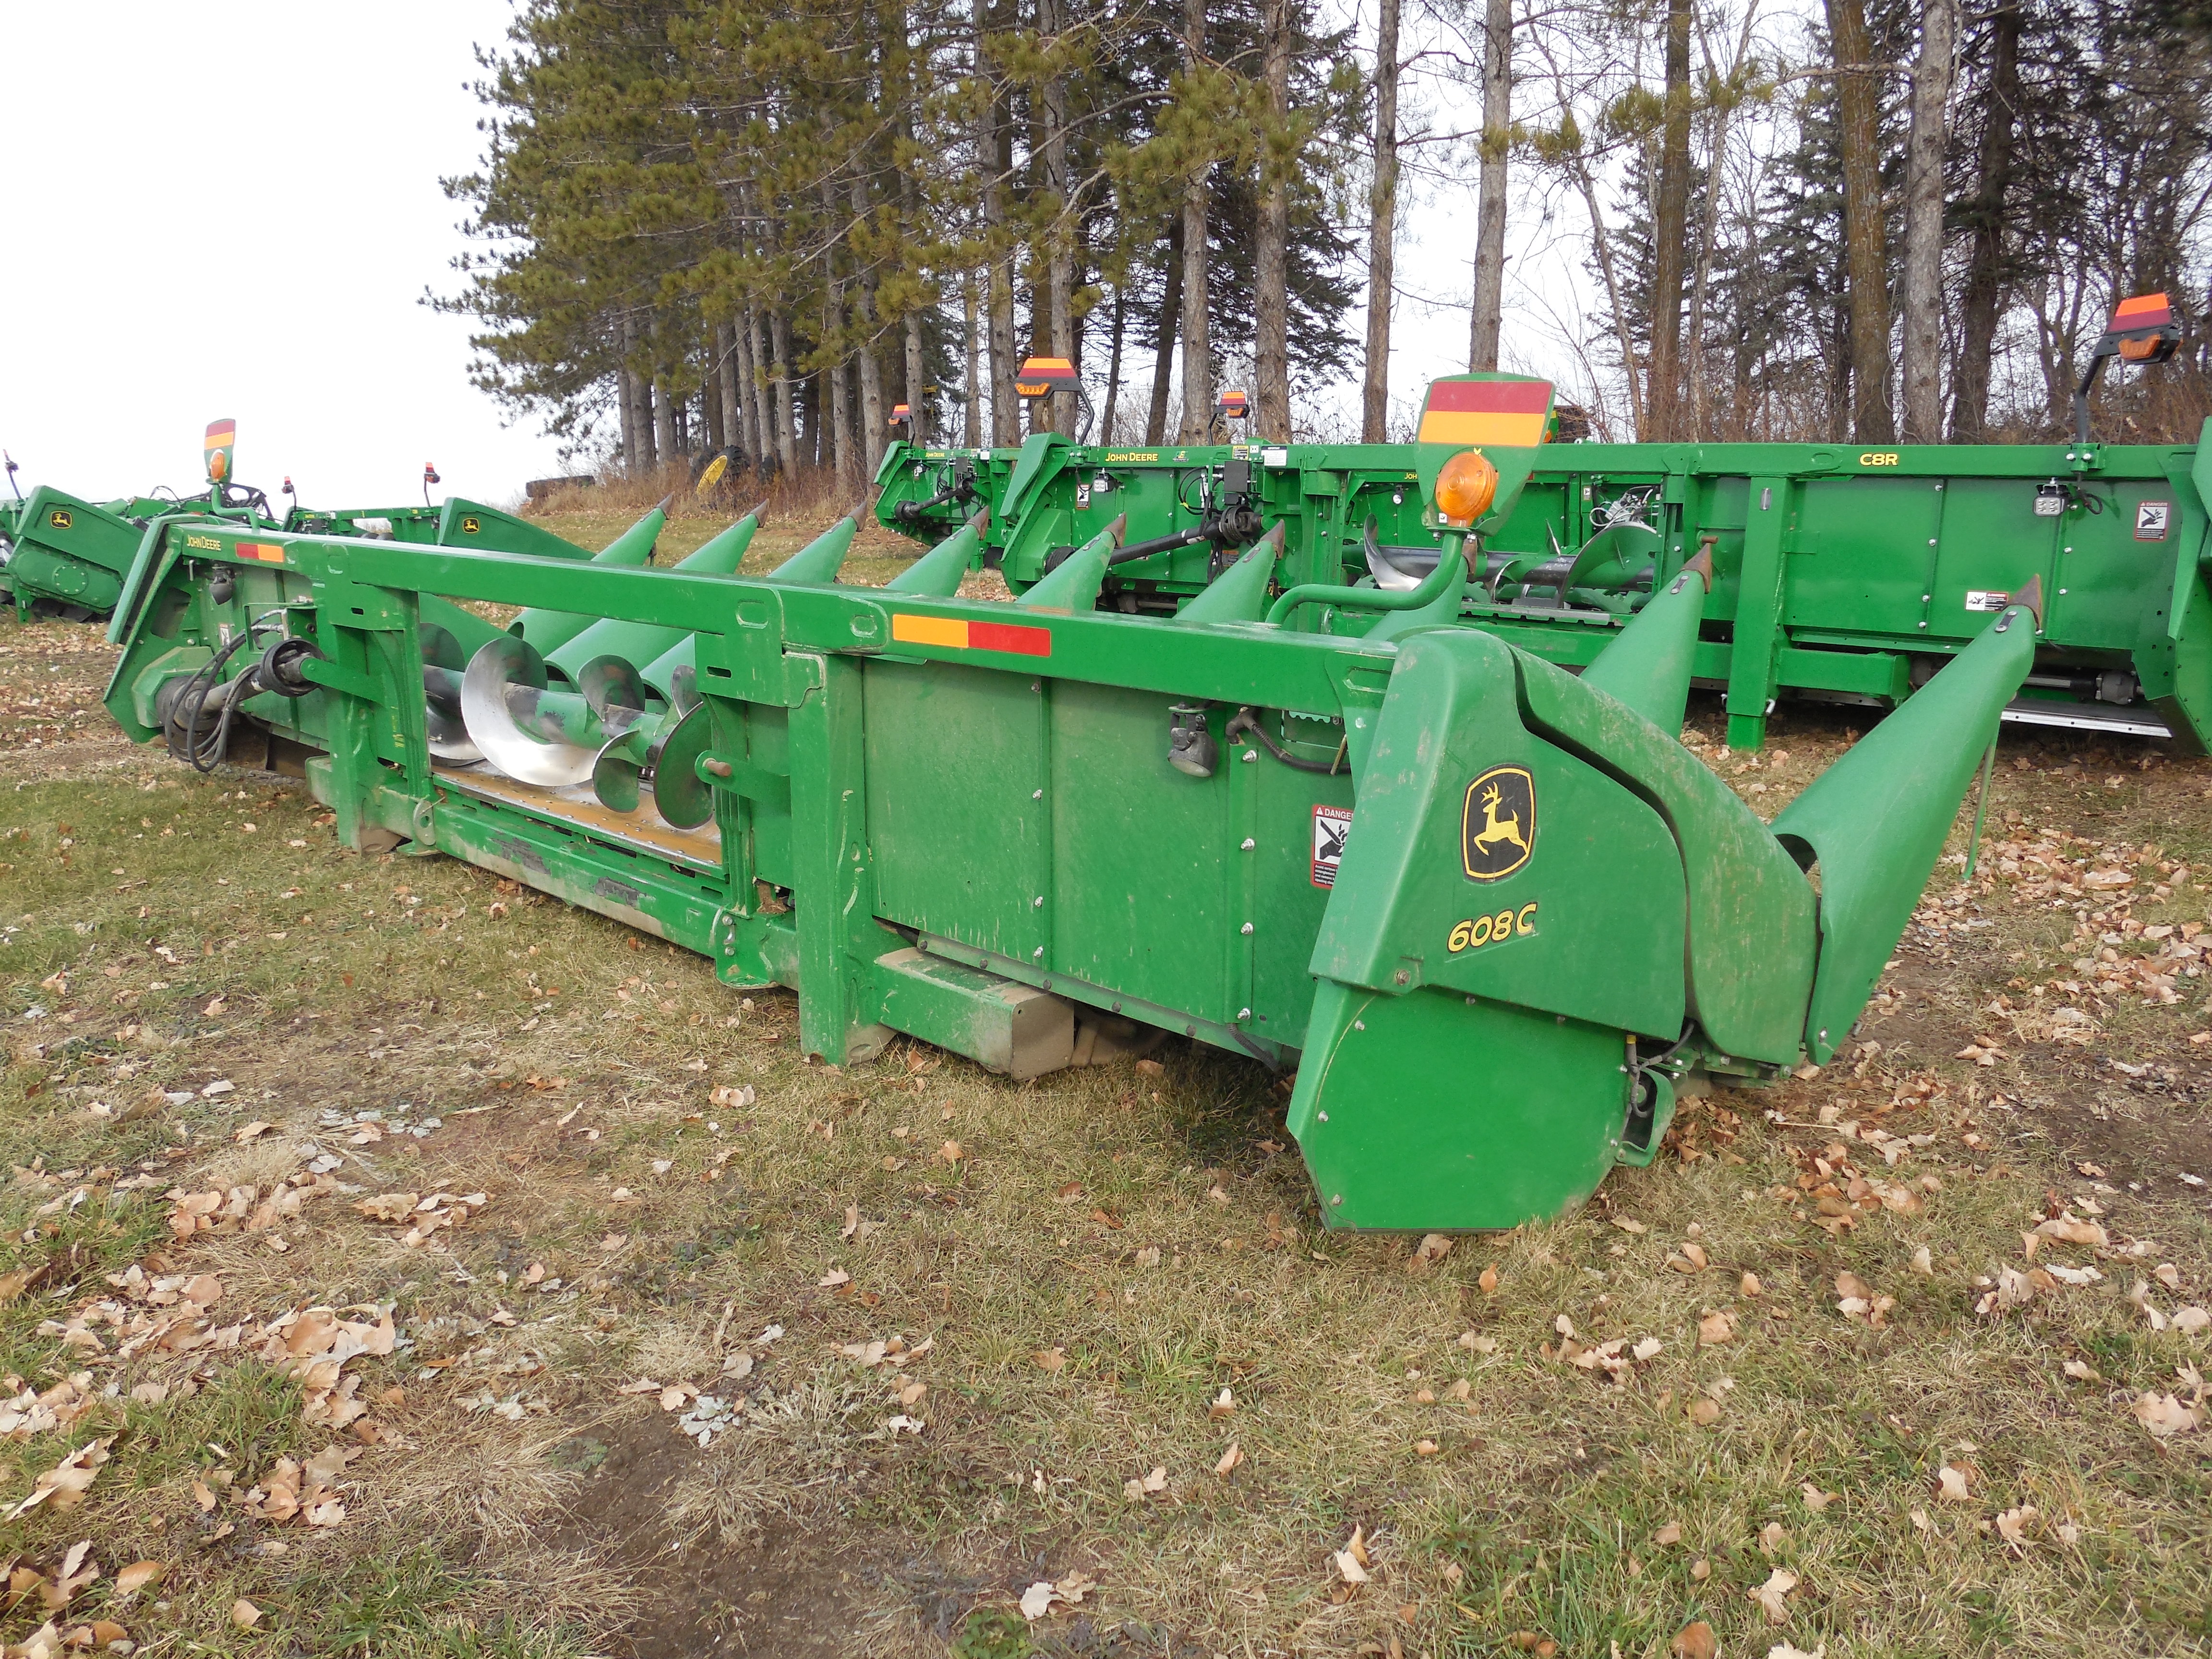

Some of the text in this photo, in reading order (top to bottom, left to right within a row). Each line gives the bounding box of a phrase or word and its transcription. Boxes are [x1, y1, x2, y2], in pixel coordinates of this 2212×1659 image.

[1105, 452, 1158, 461] JOHN DEERE
[1859, 453, 1898, 466] C8R
[187, 534, 221, 551] JOHN DEERE
[1324, 808, 1354, 820] DANGE
[1447, 902, 1538, 953] 608C
